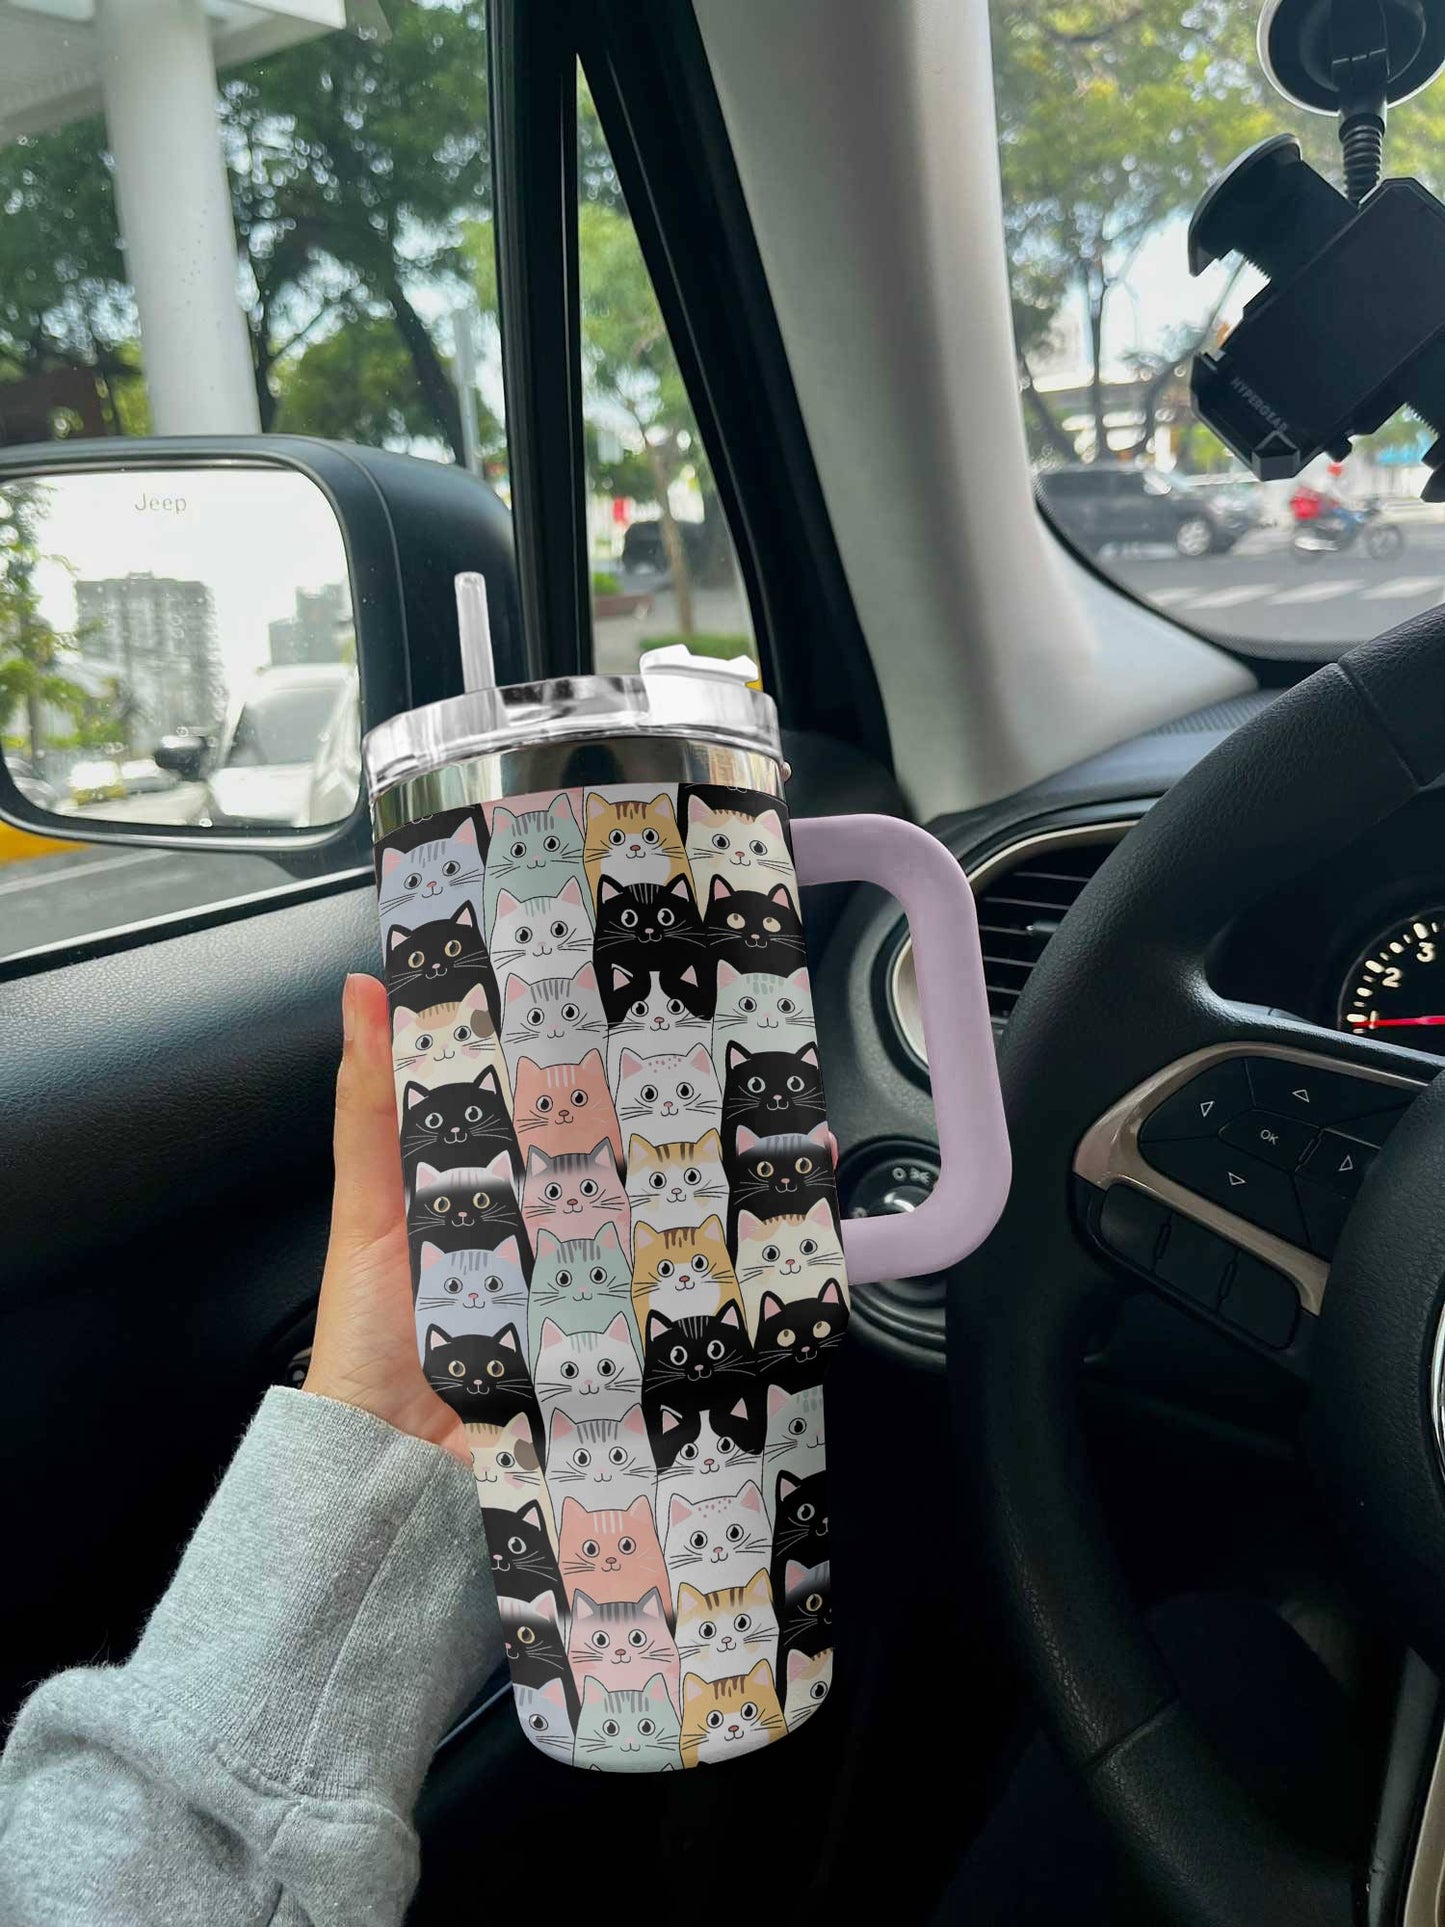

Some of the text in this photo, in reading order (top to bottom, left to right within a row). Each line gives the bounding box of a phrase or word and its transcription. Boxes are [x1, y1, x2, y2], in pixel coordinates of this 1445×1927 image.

[1230, 377, 1287, 432] HYPERGEAR
[134, 492, 186, 514] Jeep
[1416, 942, 1434, 962] 3
[1382, 967, 1402, 987] 2
[1260, 1129, 1279, 1145] OK
